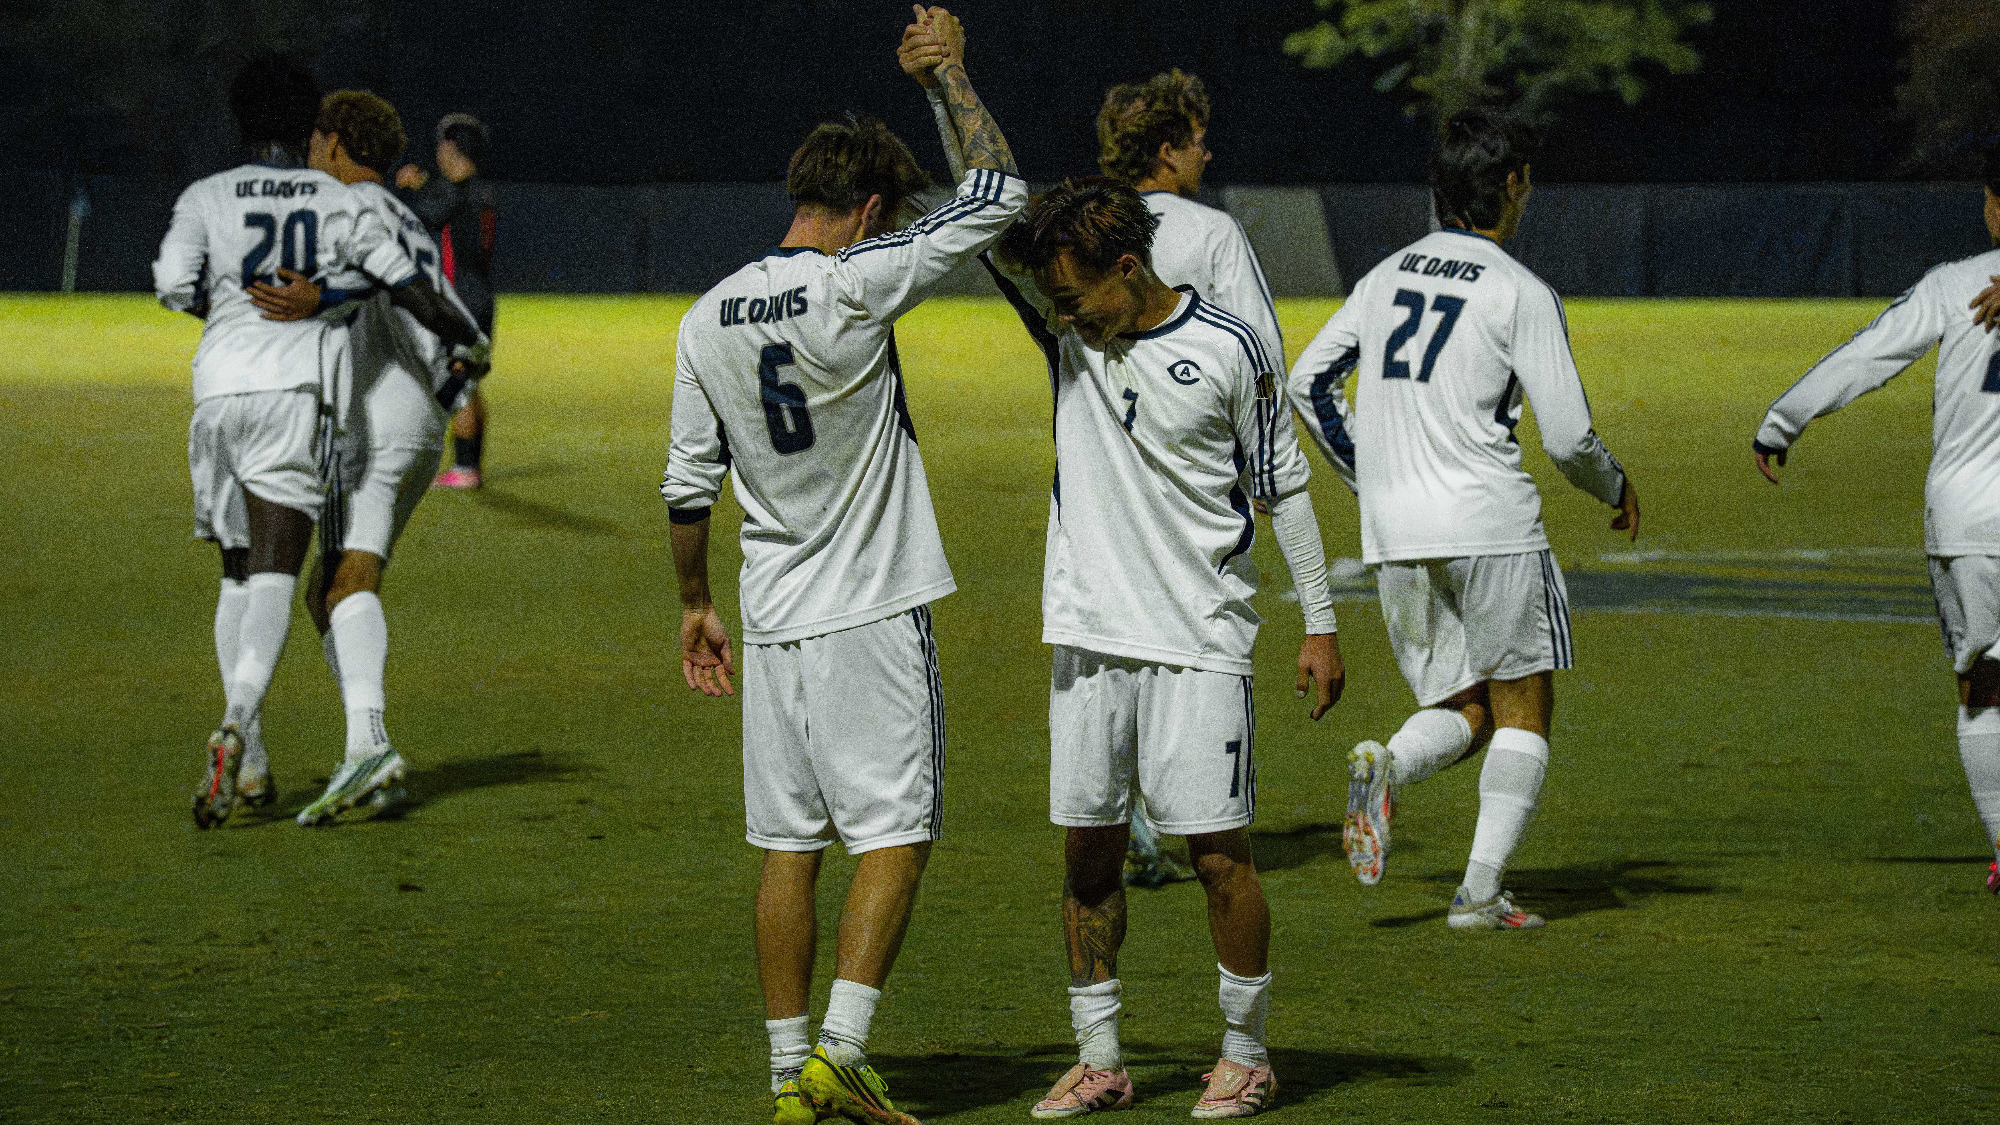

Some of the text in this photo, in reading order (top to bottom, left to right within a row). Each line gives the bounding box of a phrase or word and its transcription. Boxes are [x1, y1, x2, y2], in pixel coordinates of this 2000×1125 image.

[235, 179, 318, 199] UC DAVIS
[241, 208, 318, 290] 20
[1398, 252, 1486, 283] UC DAVIS
[720, 284, 808, 327] UC DAVIS
[1382, 287, 1468, 383] 27
[757, 341, 816, 456] 6
